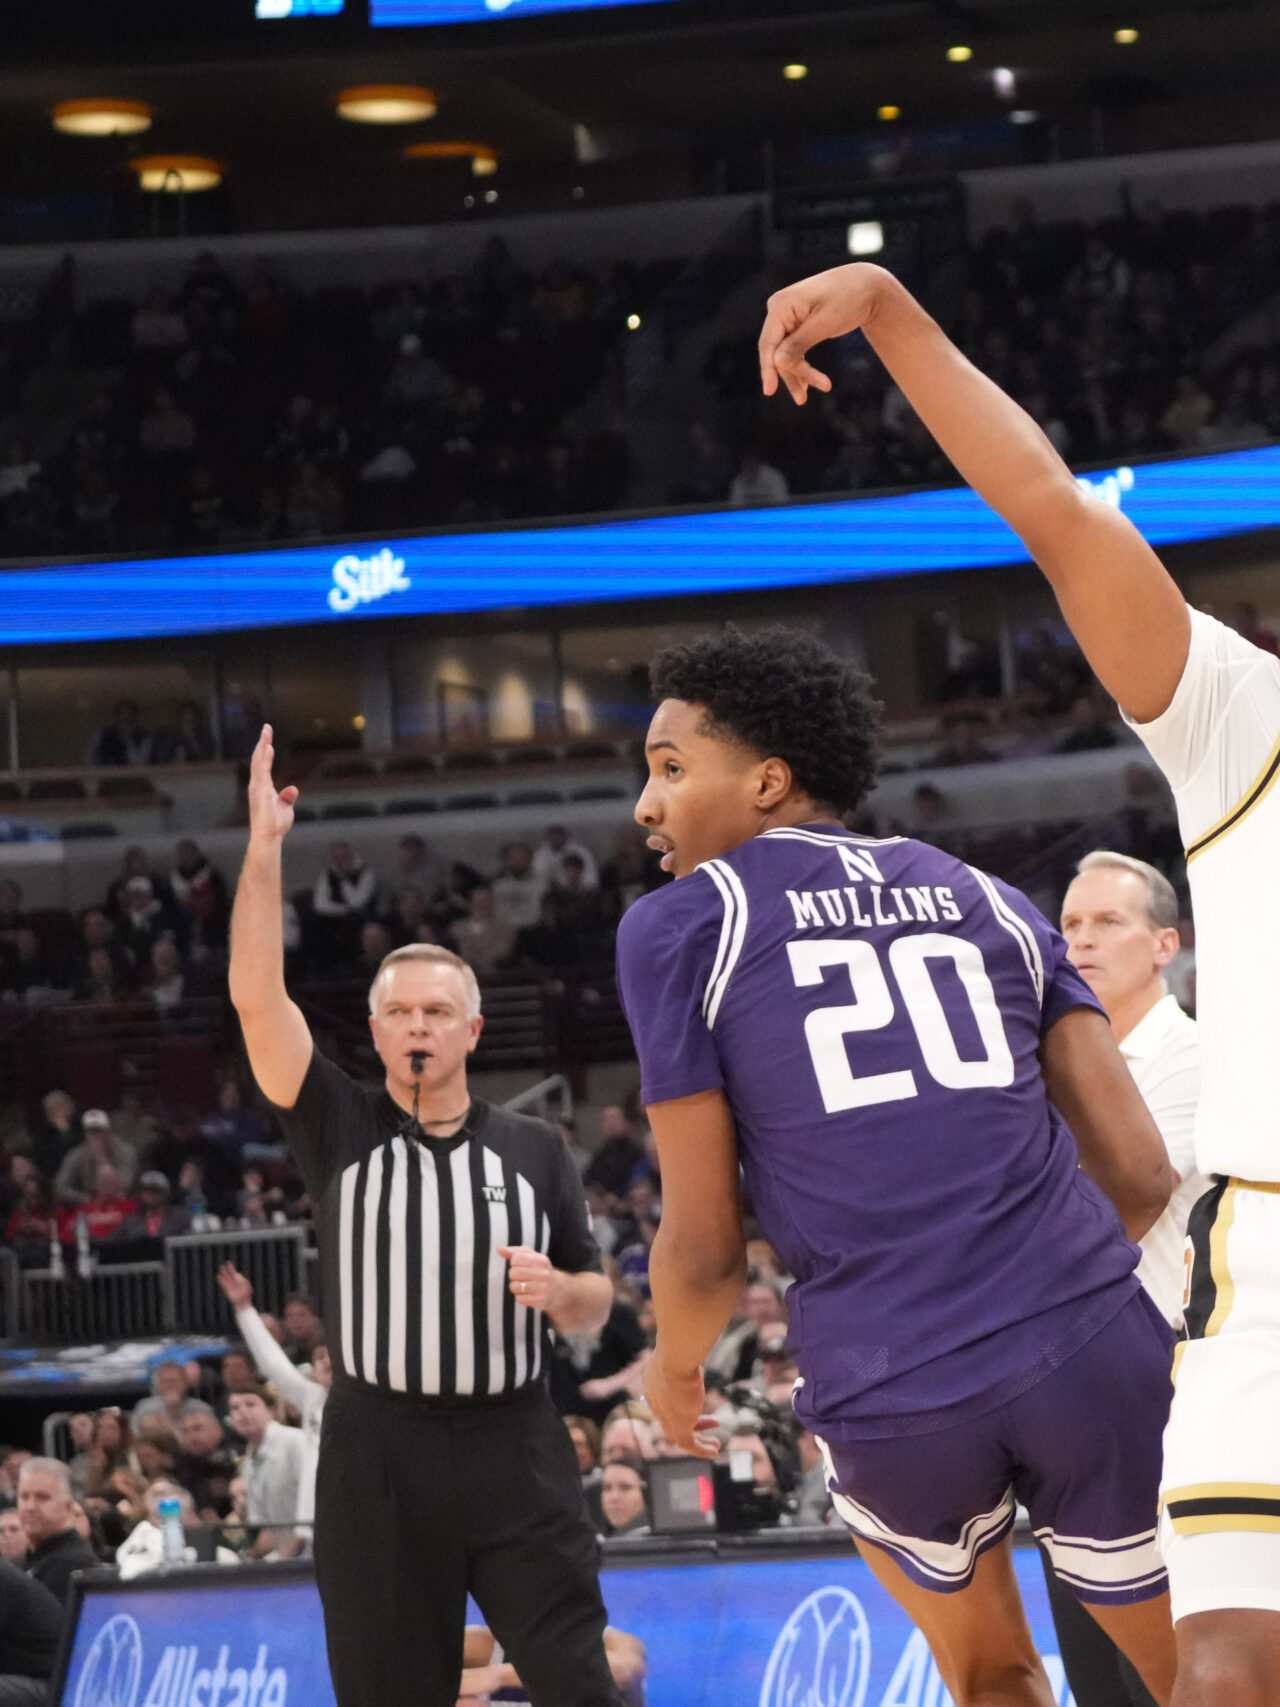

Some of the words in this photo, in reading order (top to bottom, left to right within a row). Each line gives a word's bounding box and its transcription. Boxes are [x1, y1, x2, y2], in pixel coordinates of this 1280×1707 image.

[327, 548, 411, 612] Silk
[836, 844, 885, 883] N
[785, 885, 963, 929] MULLINS
[785, 932, 1015, 1114] 20
